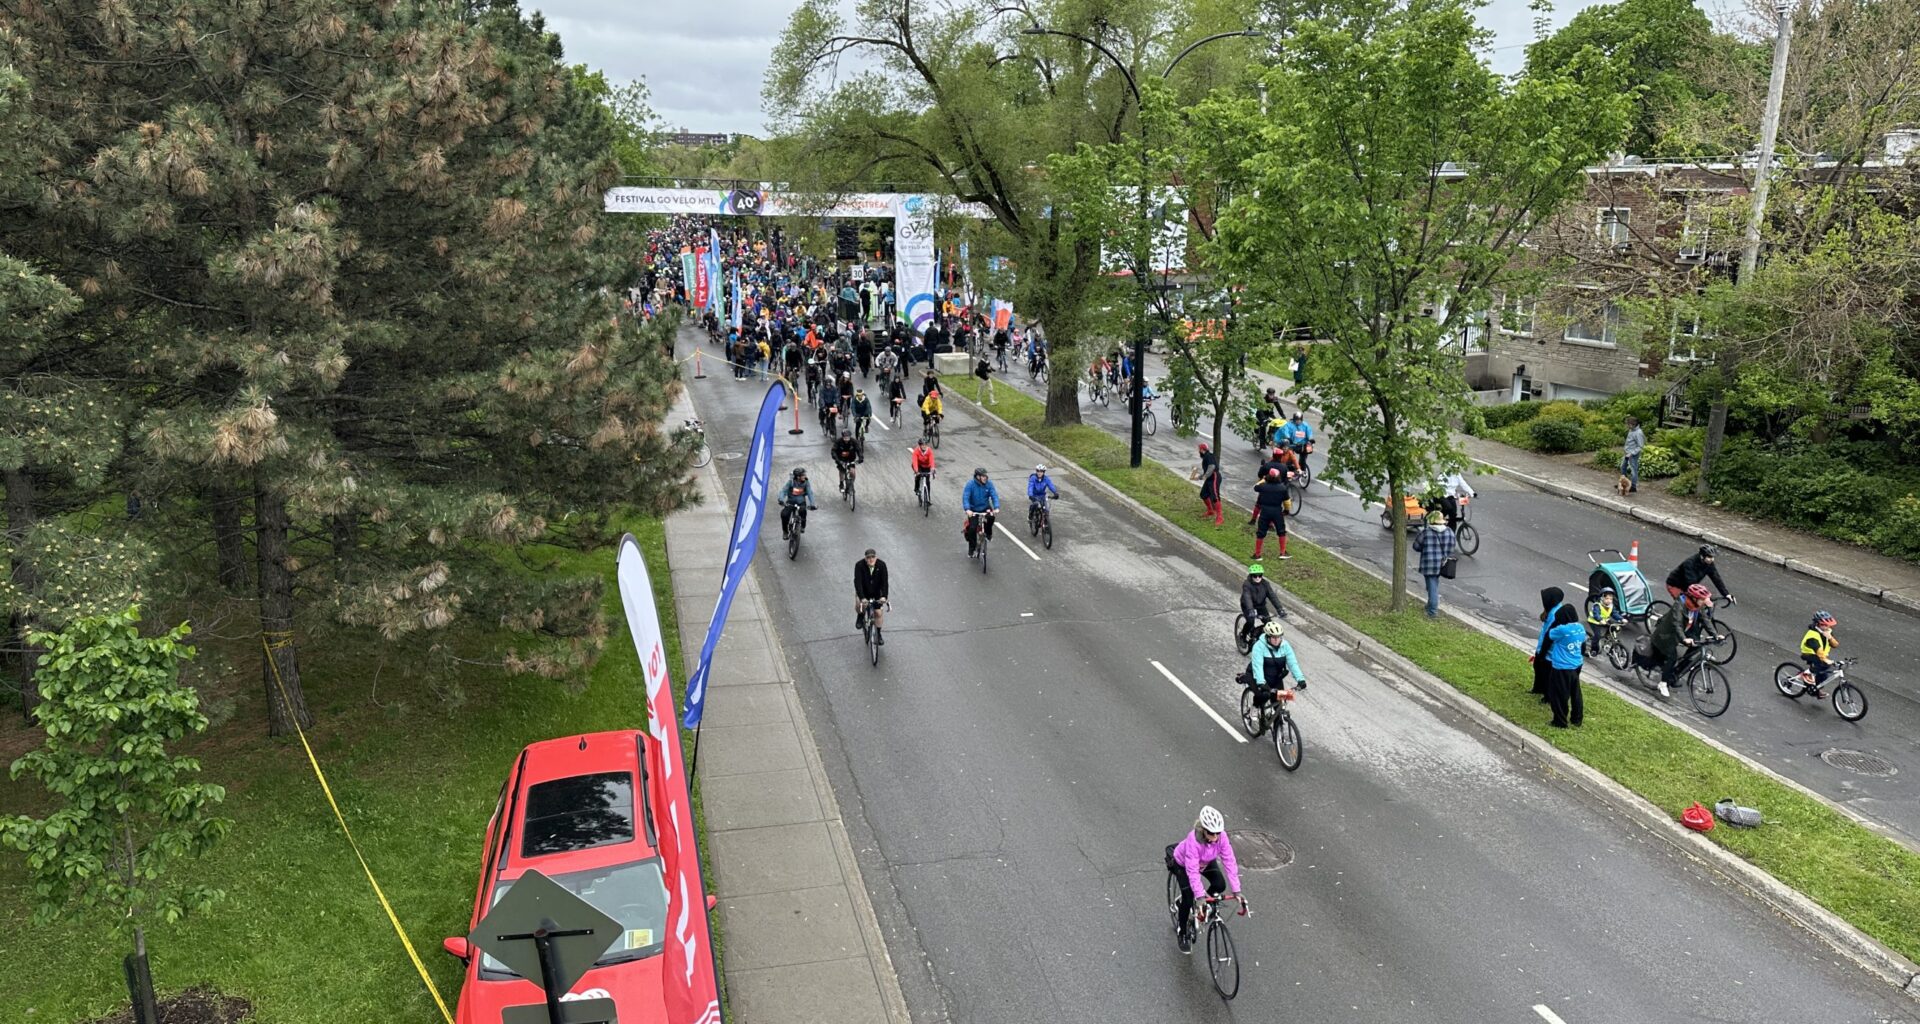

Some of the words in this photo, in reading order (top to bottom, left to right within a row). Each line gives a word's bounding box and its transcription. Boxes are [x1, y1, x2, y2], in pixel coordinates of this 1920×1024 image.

[615, 195, 655, 204] FESTIVAL
[657, 196, 671, 204] GO
[698, 197, 716, 205] MTL
[853, 270, 863, 278] 30
